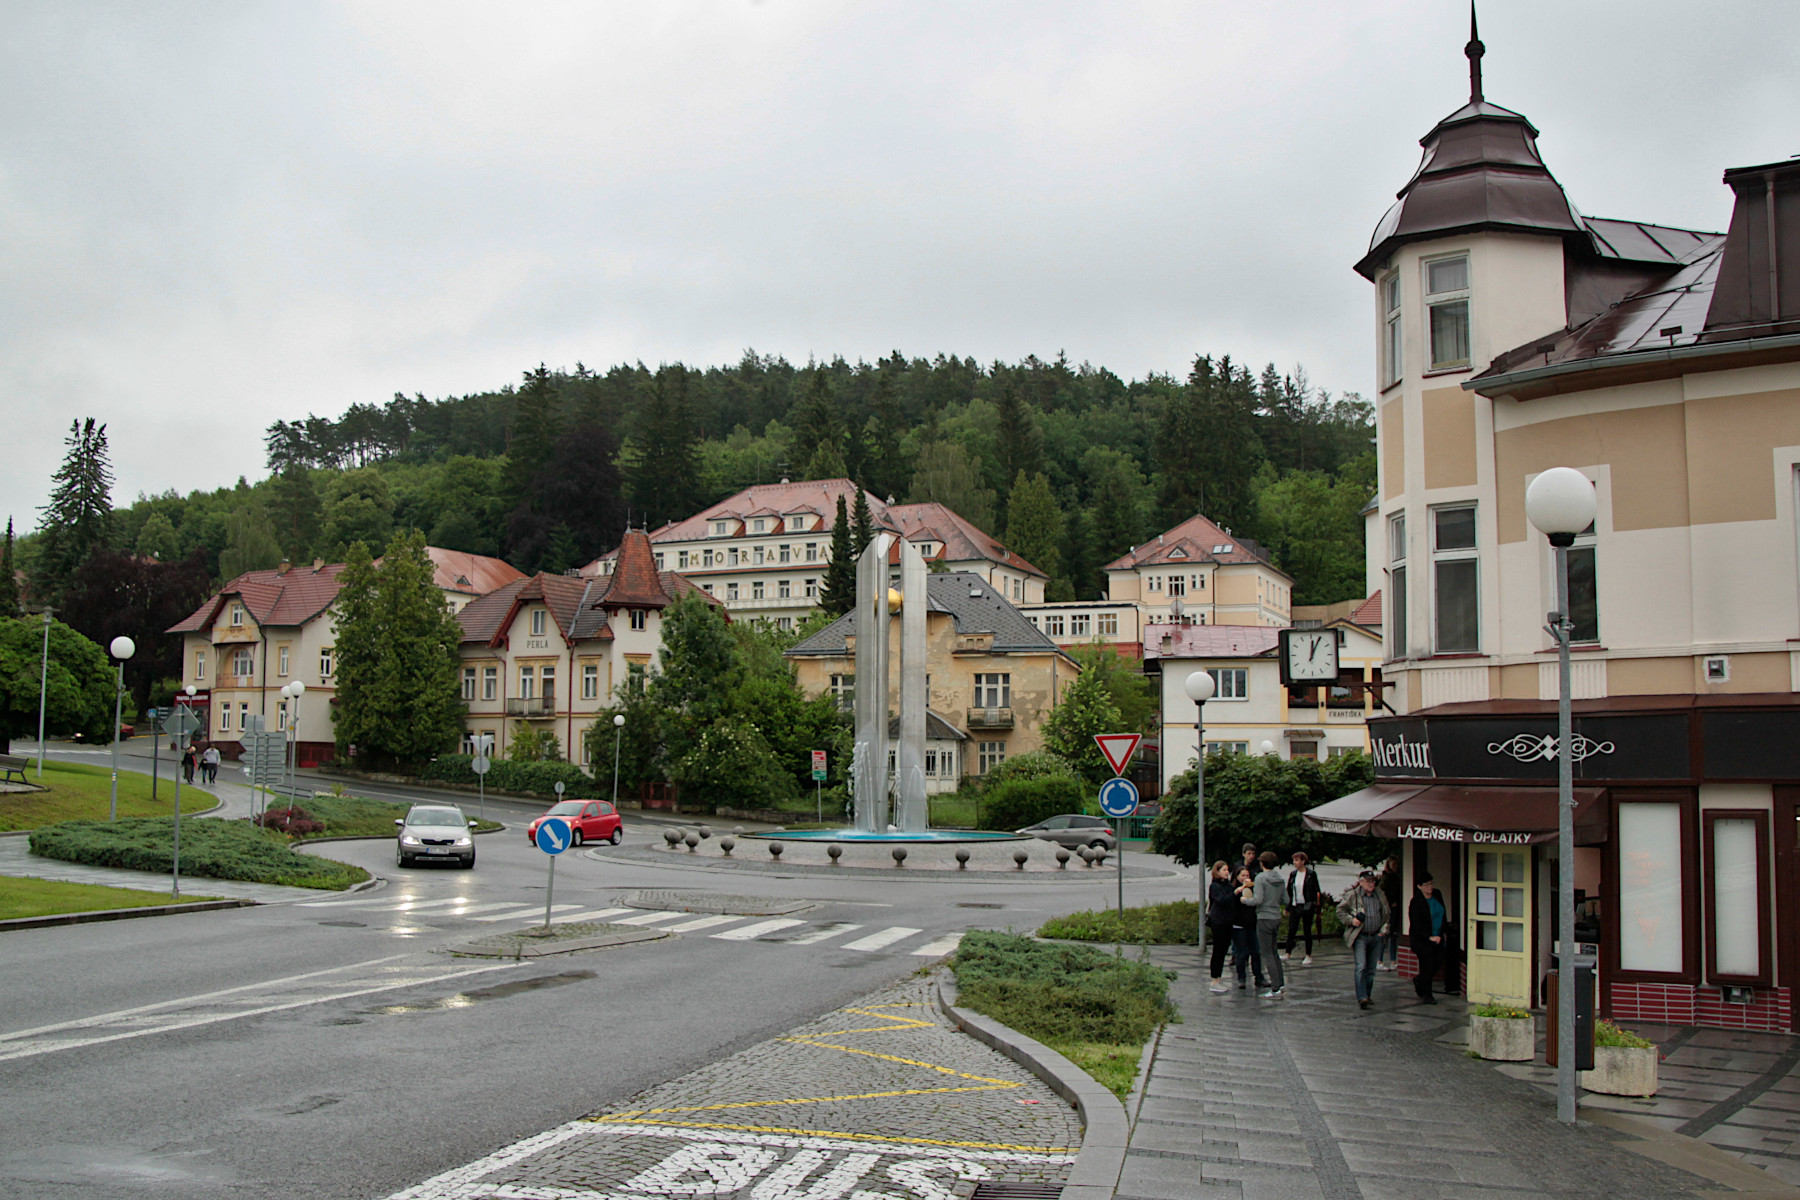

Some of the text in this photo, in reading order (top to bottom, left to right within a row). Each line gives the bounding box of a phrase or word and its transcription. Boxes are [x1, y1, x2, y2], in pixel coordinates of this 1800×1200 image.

[689, 545, 828, 565] MORAVA
[526, 639, 549, 649] PERLA
[1371, 733, 1431, 769] Merkur
[1473, 831, 1532, 844] OPLATKY
